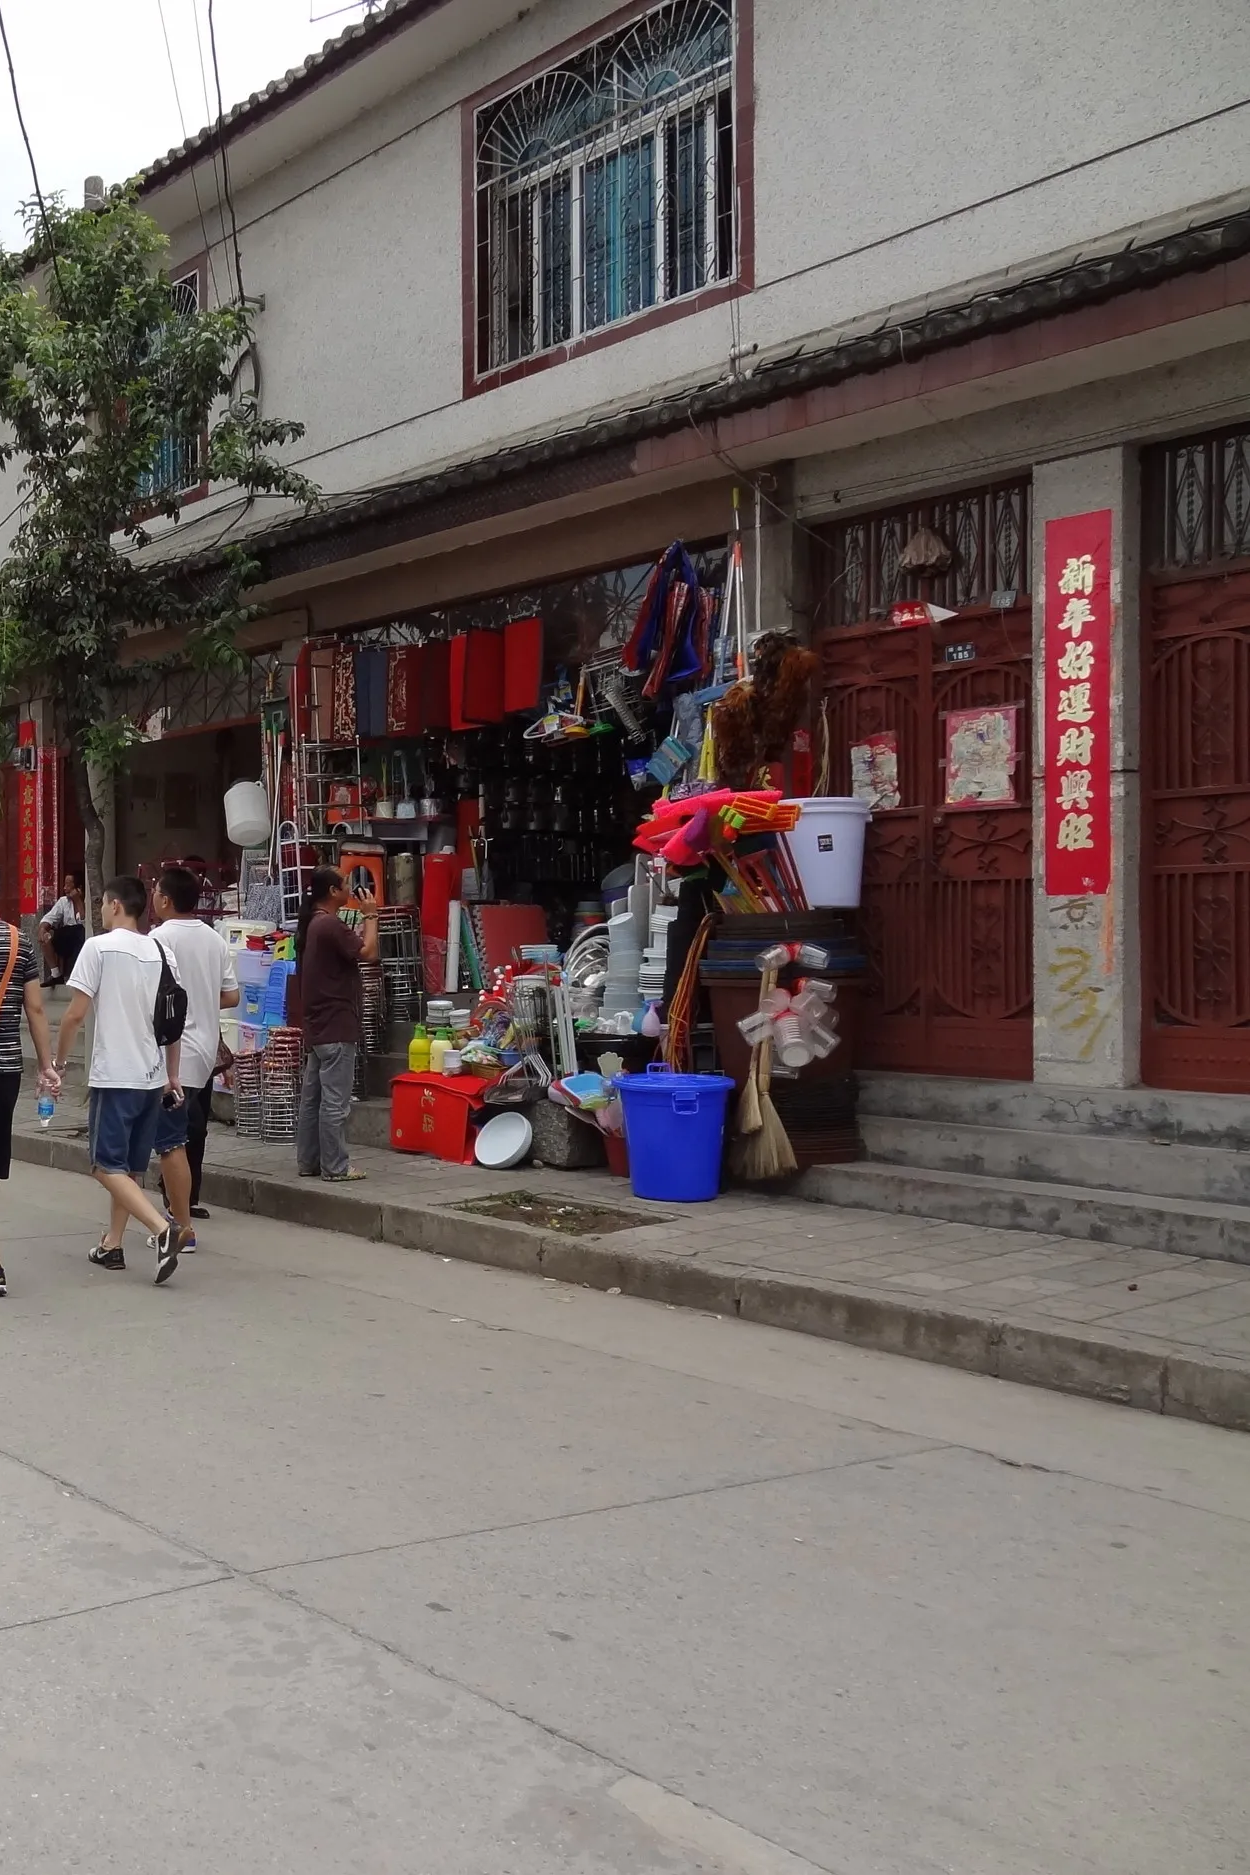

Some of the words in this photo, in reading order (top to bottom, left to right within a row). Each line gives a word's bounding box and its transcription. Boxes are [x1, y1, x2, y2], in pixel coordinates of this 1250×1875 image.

[952, 651, 969, 660] 185
[1057, 553, 1096, 852] 新年好運財興旺
